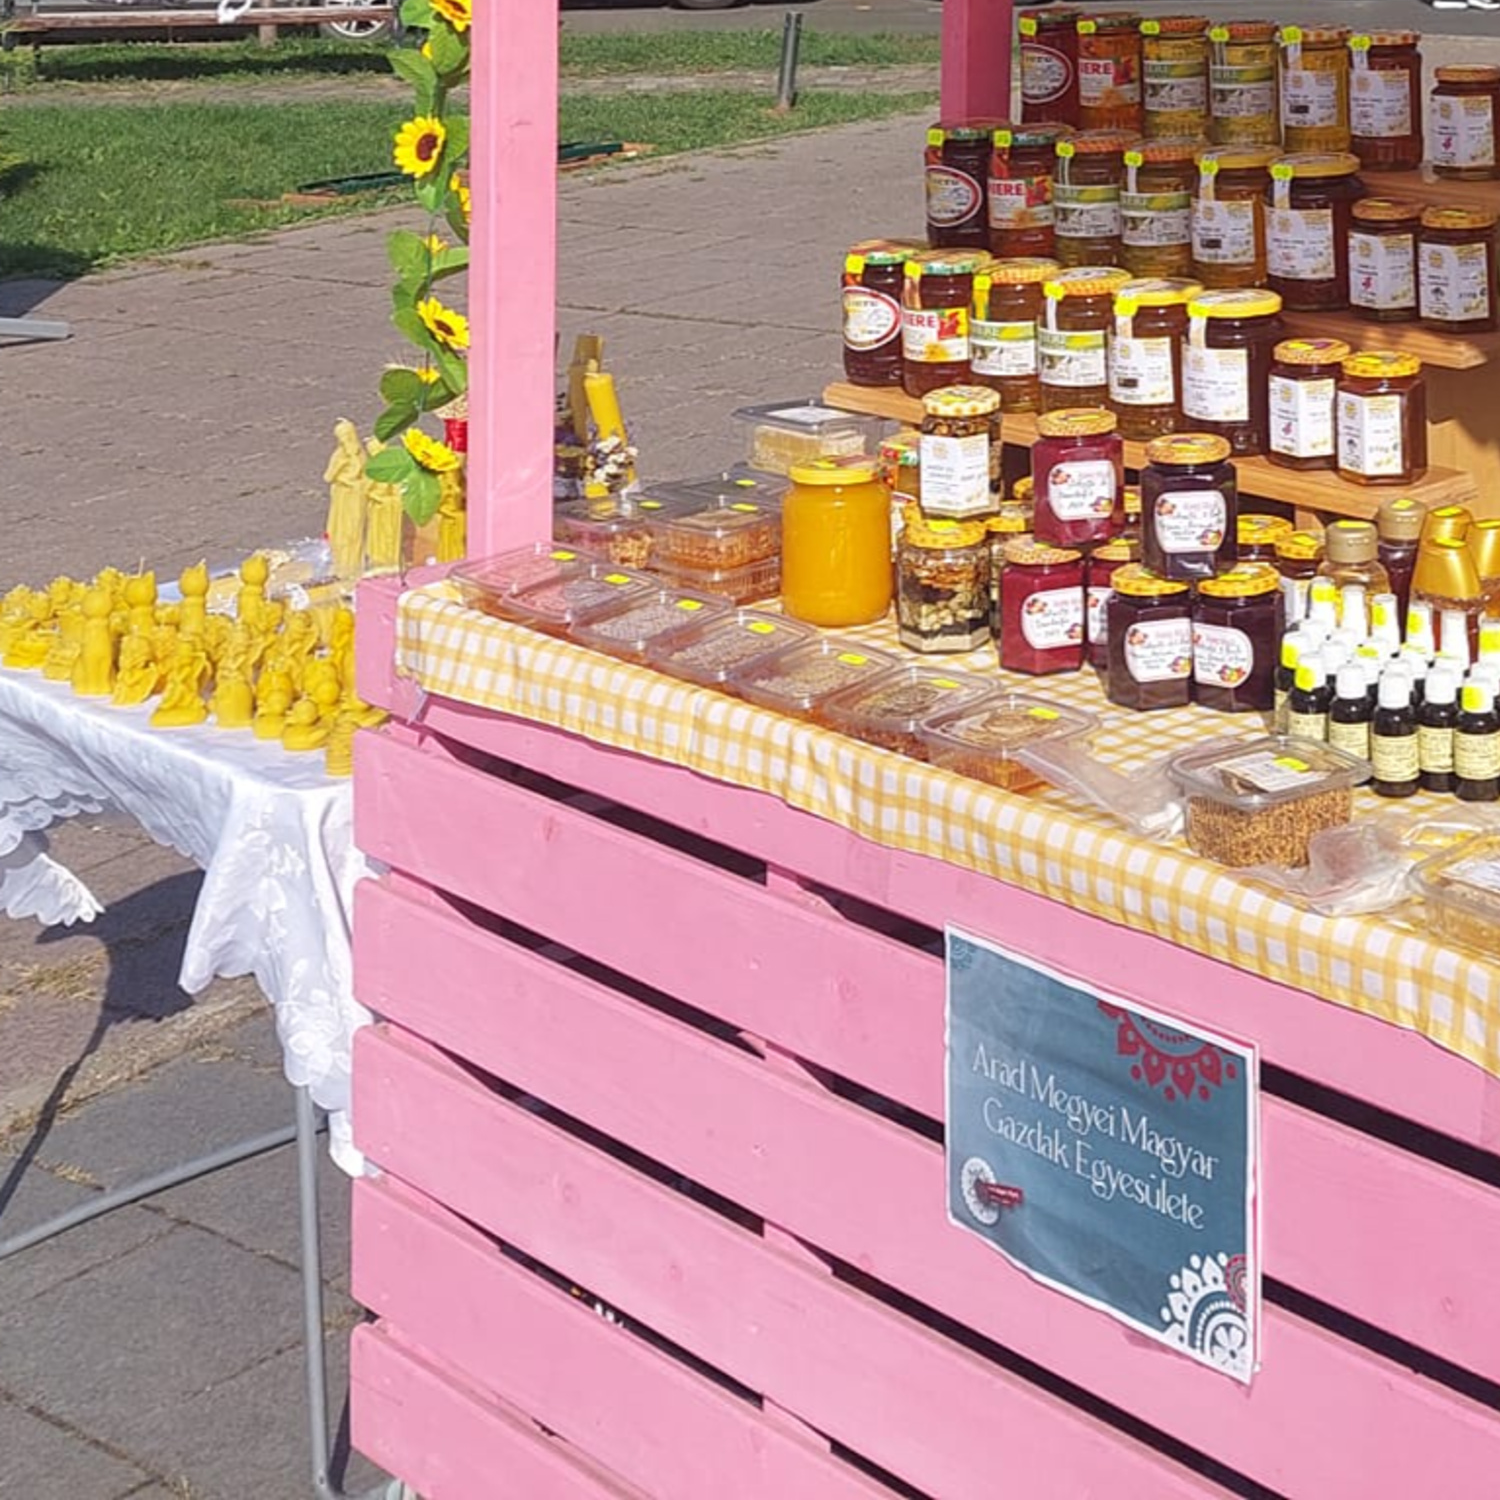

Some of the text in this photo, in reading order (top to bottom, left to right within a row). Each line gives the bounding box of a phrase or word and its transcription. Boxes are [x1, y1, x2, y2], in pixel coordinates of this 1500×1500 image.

[973, 1043, 1219, 1180] Arad Megyei Magyar
